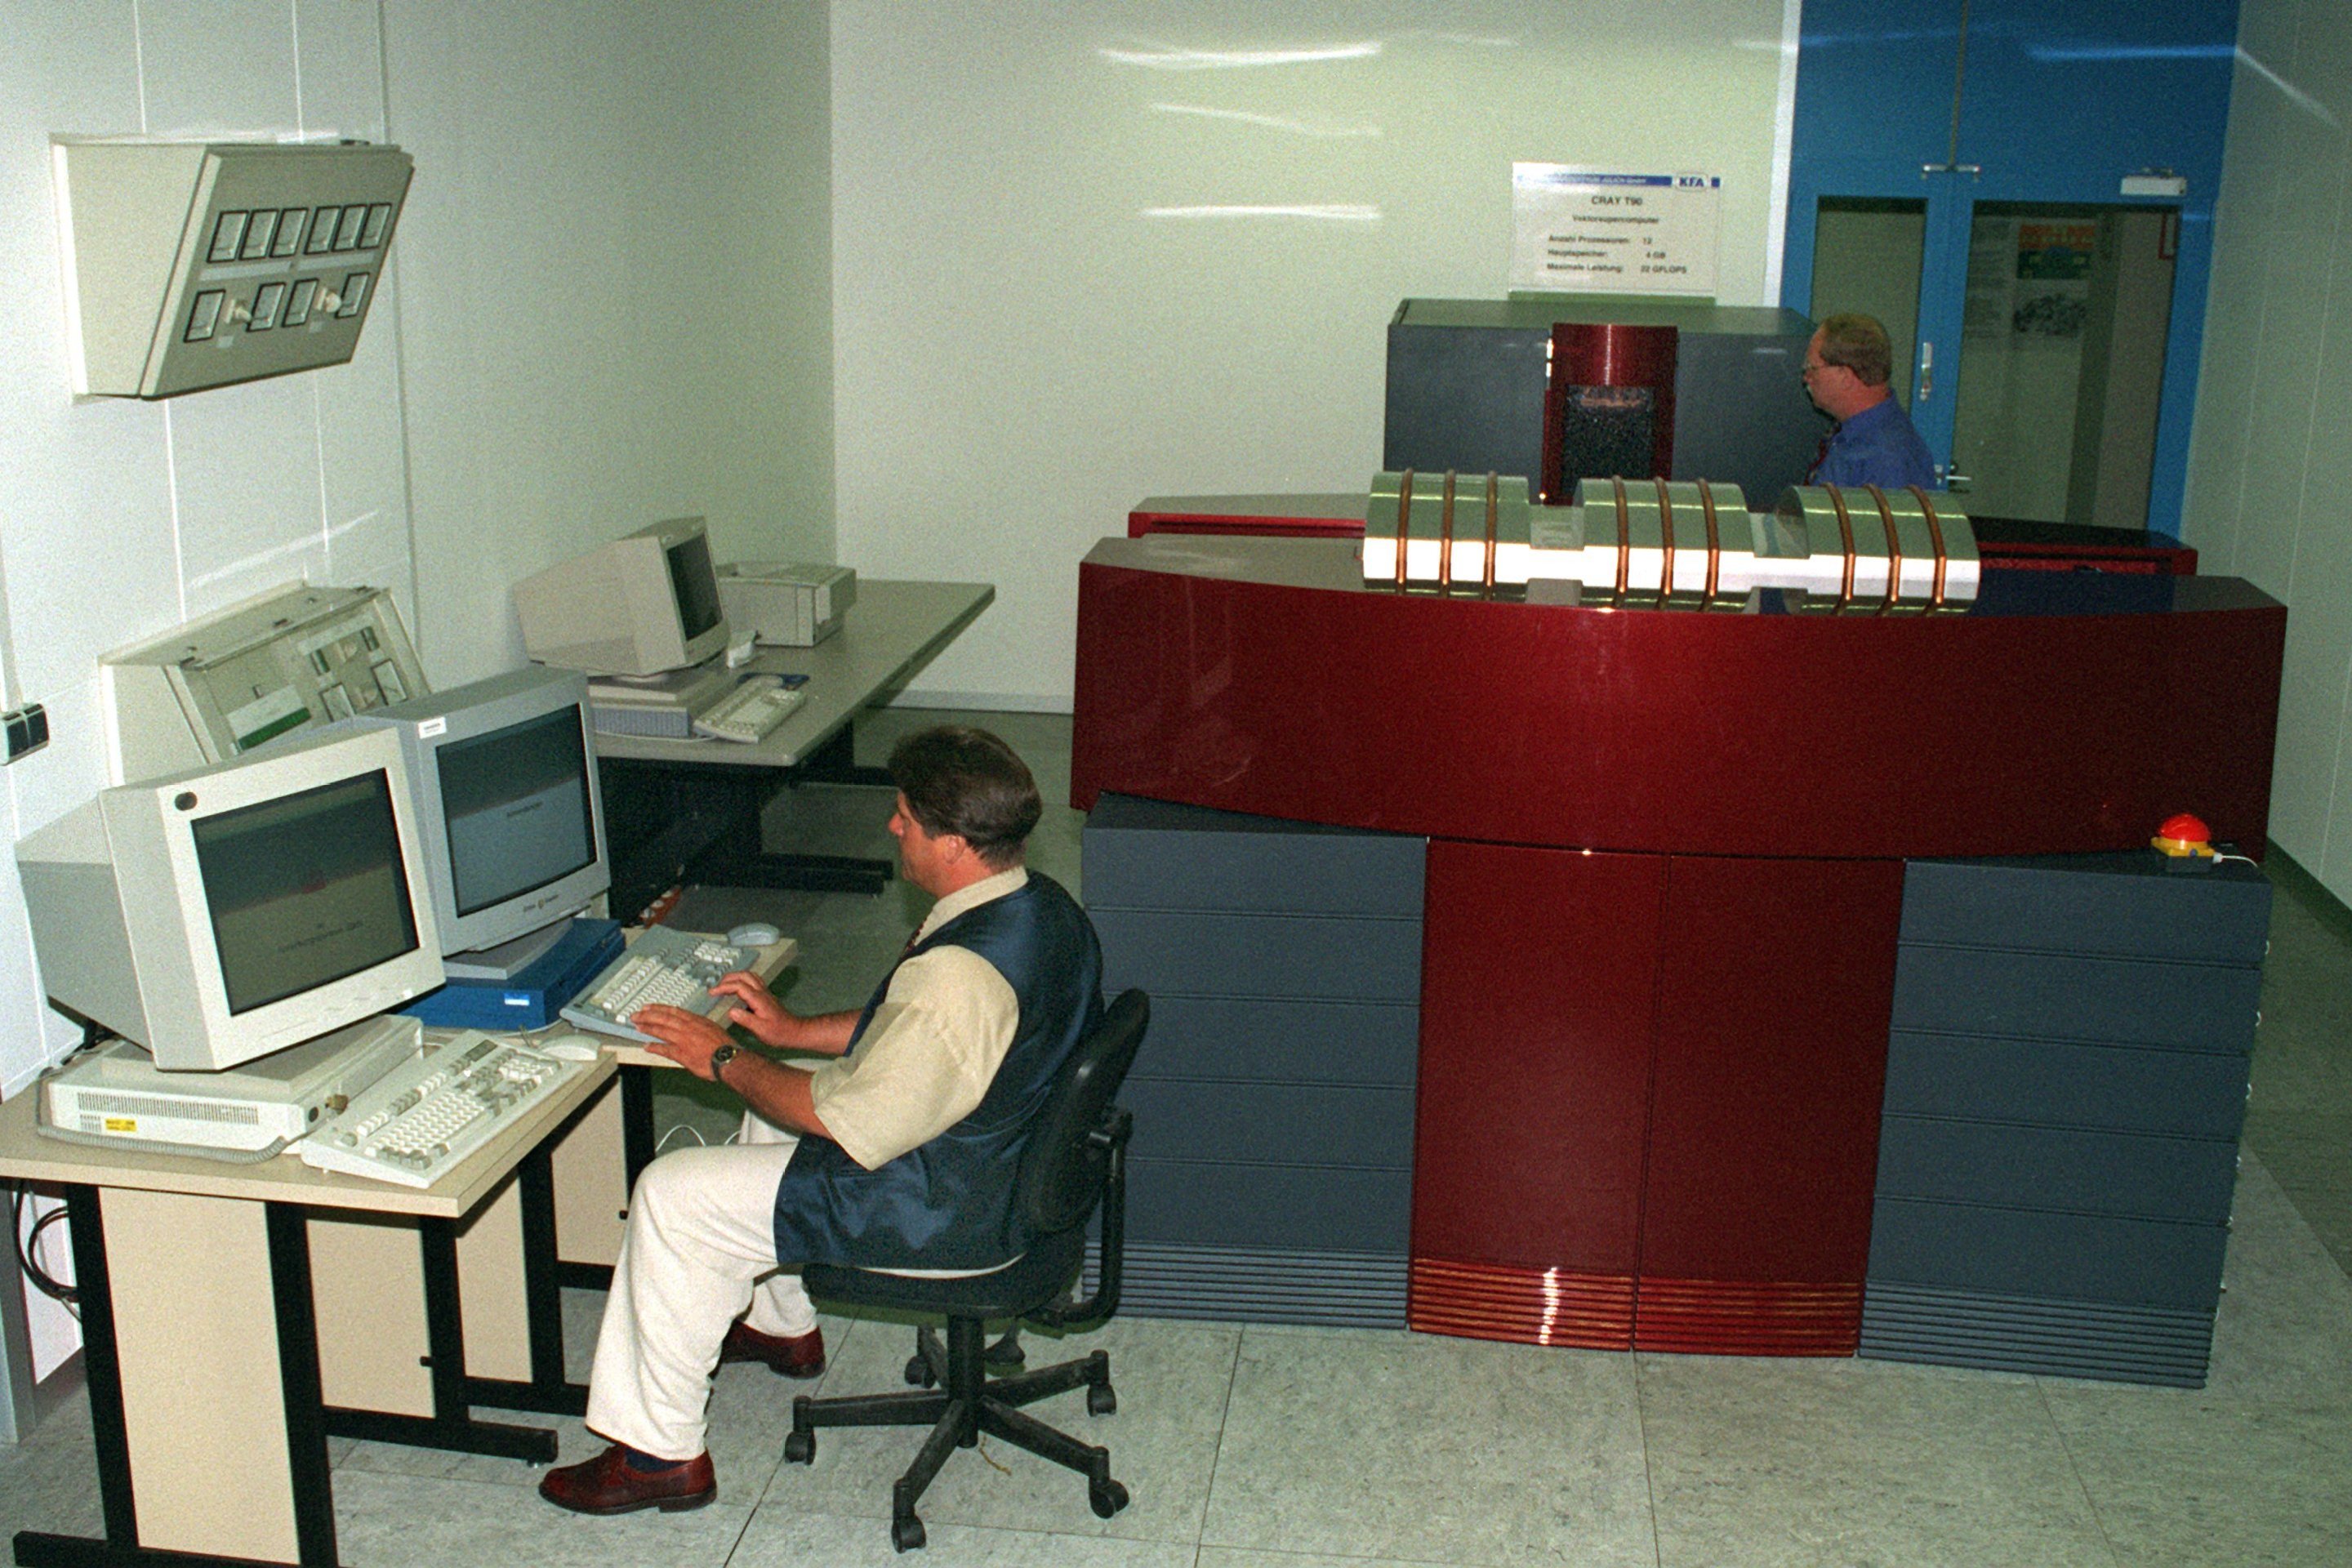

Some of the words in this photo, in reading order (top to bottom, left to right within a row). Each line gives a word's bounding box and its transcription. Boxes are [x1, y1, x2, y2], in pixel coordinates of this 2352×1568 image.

[1679, 176, 1704, 187] KFA
[1591, 195, 1621, 205] CRAY
[1624, 196, 1643, 206] T90
